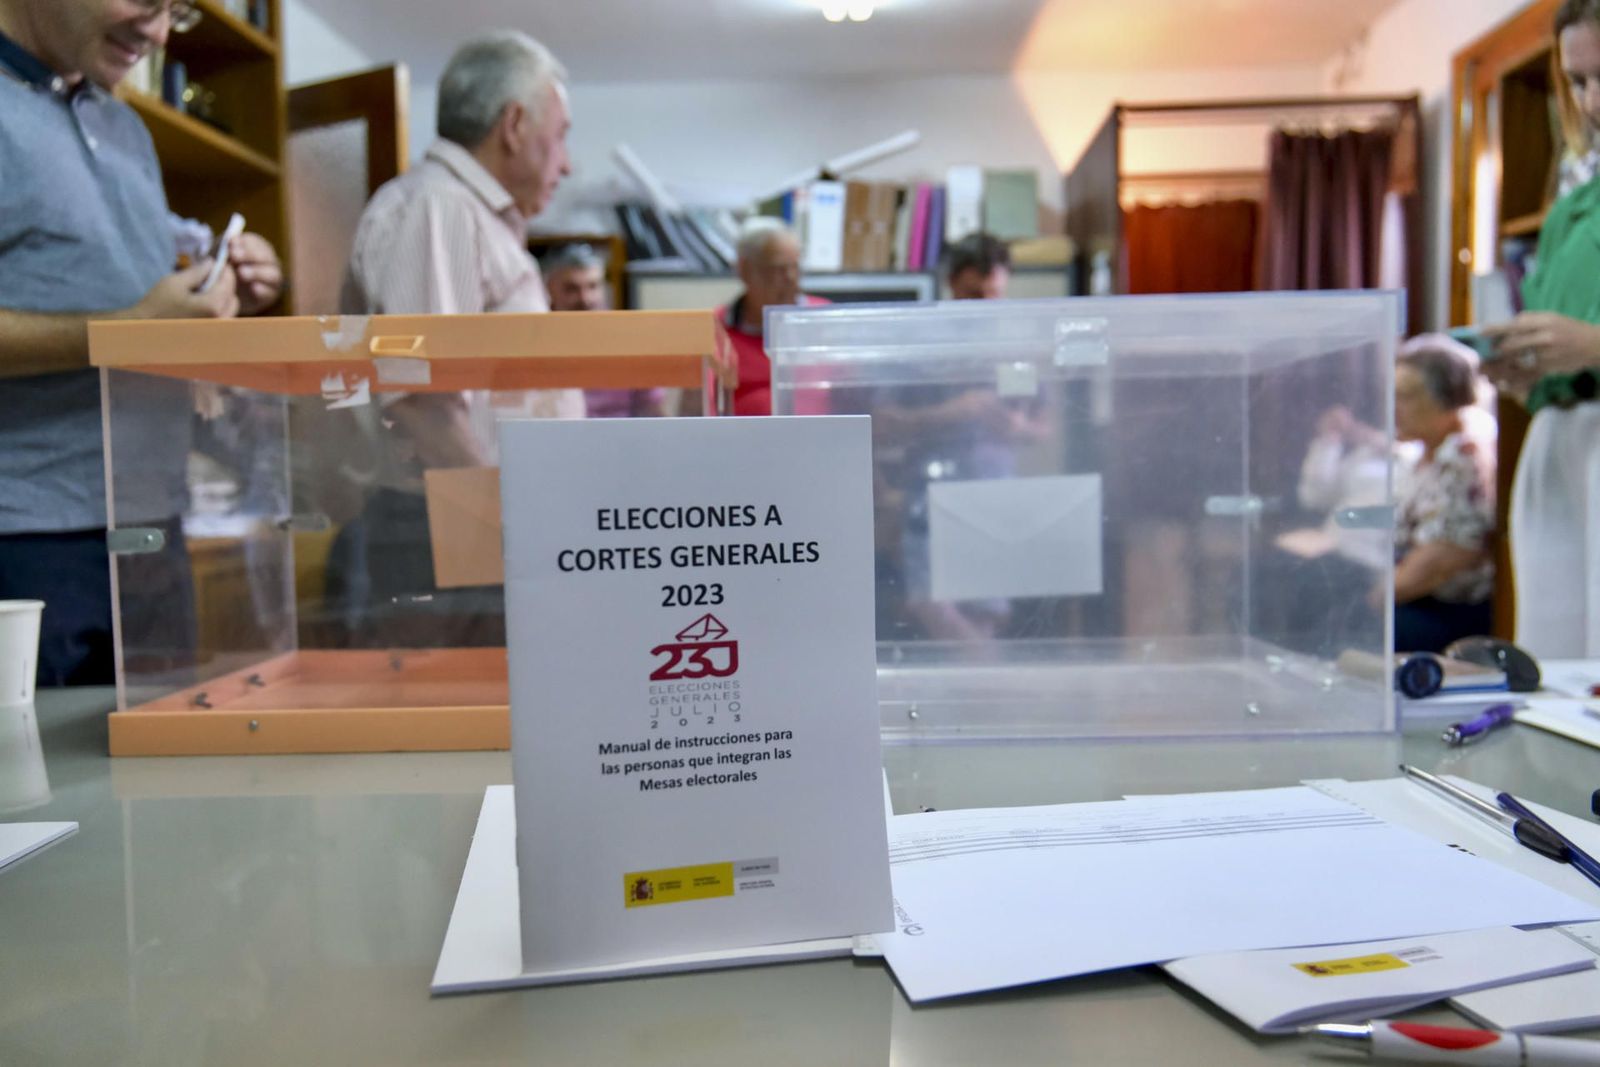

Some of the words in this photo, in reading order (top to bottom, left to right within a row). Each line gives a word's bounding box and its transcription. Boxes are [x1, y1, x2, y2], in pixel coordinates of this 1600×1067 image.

[597, 505, 757, 531] ELECCIONES
[763, 504, 782, 526] A
[557, 546, 662, 572] CORTES
[670, 541, 820, 568] GENERALES
[661, 583, 724, 607] 2023
[649, 680, 740, 695] ELECCIONES
[649, 691, 741, 705] GENERALES
[649, 701, 741, 719] JULIO
[650, 714, 741, 729] 2023
[598, 738, 651, 755] Manual
[654, 738, 672, 751] de
[675, 732, 761, 749] instrucciones
[764, 730, 793, 743] para
[601, 763, 620, 775] las
[624, 758, 685, 775] personas
[688, 755, 713, 769] que
[717, 749, 771, 765] integran
[774, 748, 792, 760] las
[639, 776, 683, 791] Mesas
[686, 770, 758, 787] electorales
